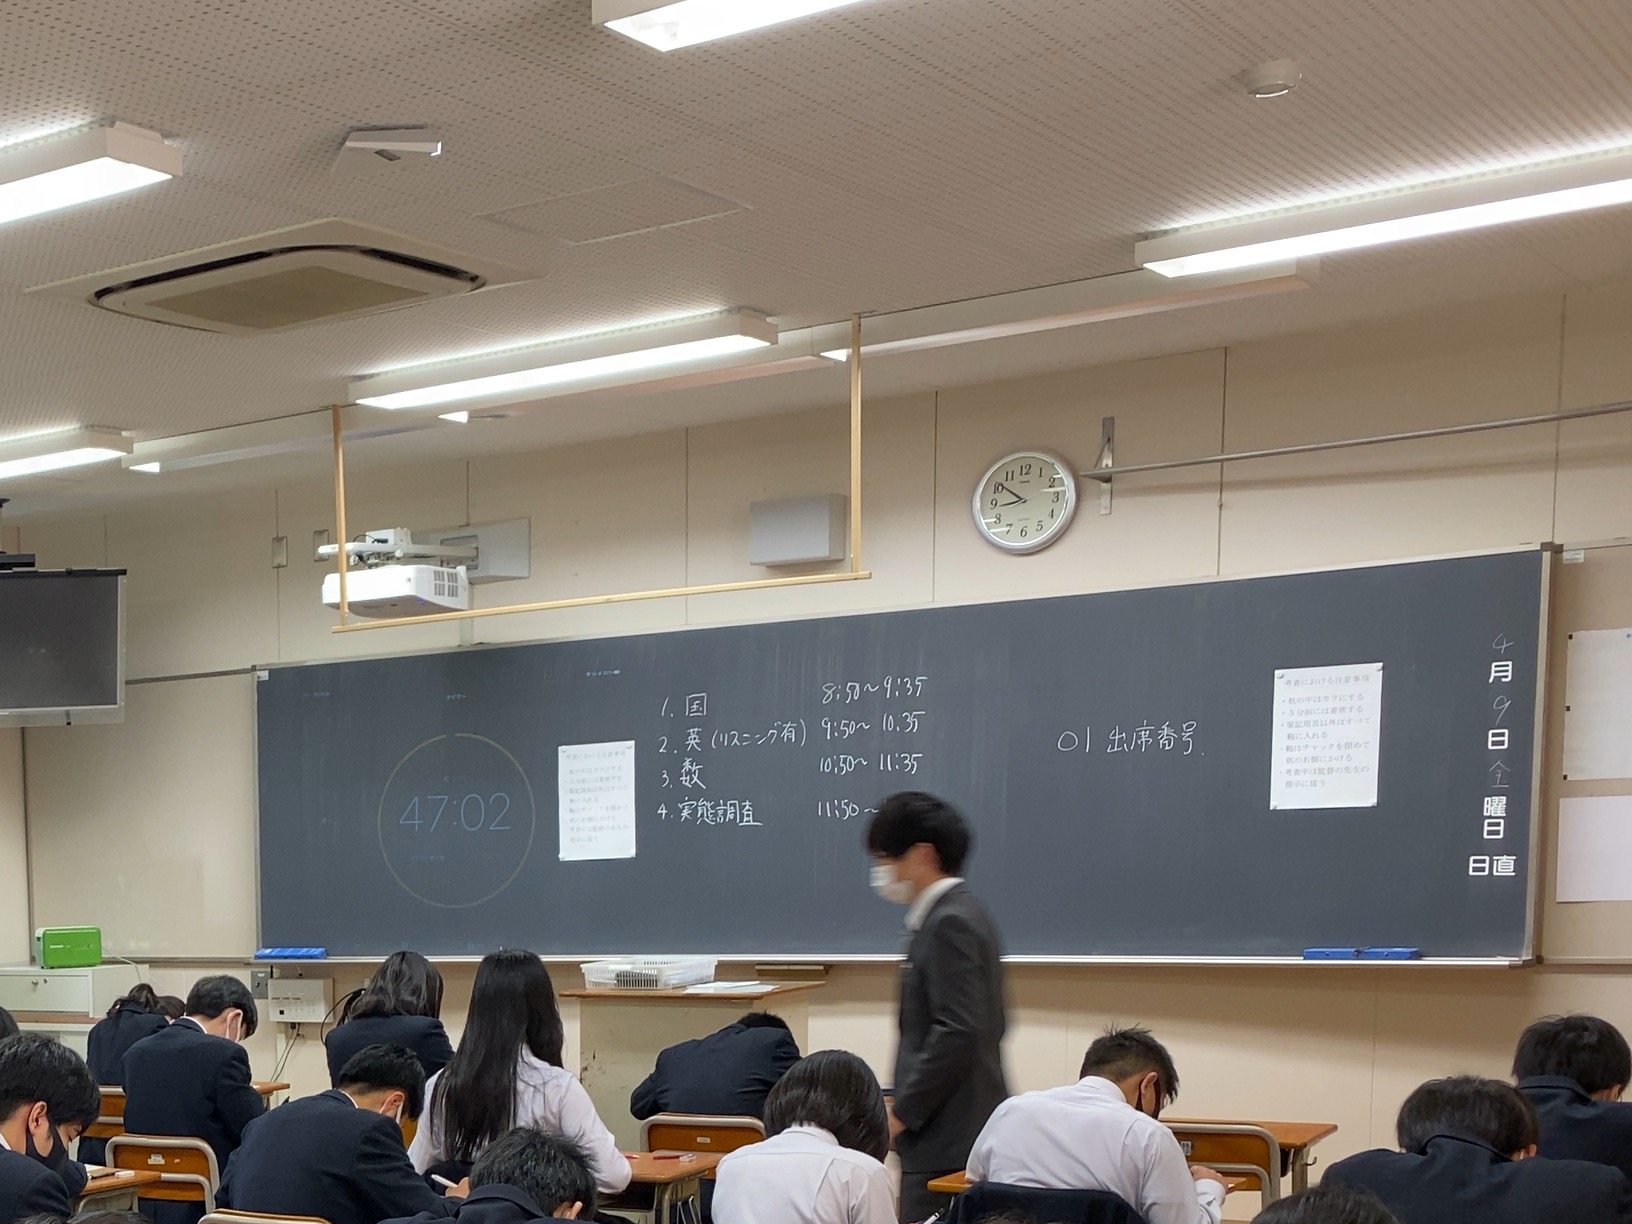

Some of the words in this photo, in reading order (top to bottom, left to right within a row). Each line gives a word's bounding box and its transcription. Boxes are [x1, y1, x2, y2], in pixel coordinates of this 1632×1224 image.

[1019, 463, 1032, 476] 12
[1039, 467, 1043, 478] 1
[1005, 470, 1014, 482] 11
[1048, 476, 1056, 488] 2
[993, 482, 1004, 494] 10
[1052, 491, 1060, 503] 3
[990, 498, 998, 510] 9
[994, 513, 1002, 525] 8
[1048, 508, 1054, 519] 4
[1006, 523, 1013, 535] 7
[1020, 525, 1028, 538] 6
[1035, 520, 1043, 532] 5
[685, 692, 707, 716] 国
[679, 757, 706, 790] 数
[399, 792, 512, 832] 47:02
[677, 796, 764, 826] 実態調査
[1468, 855, 1517, 876] 日直
